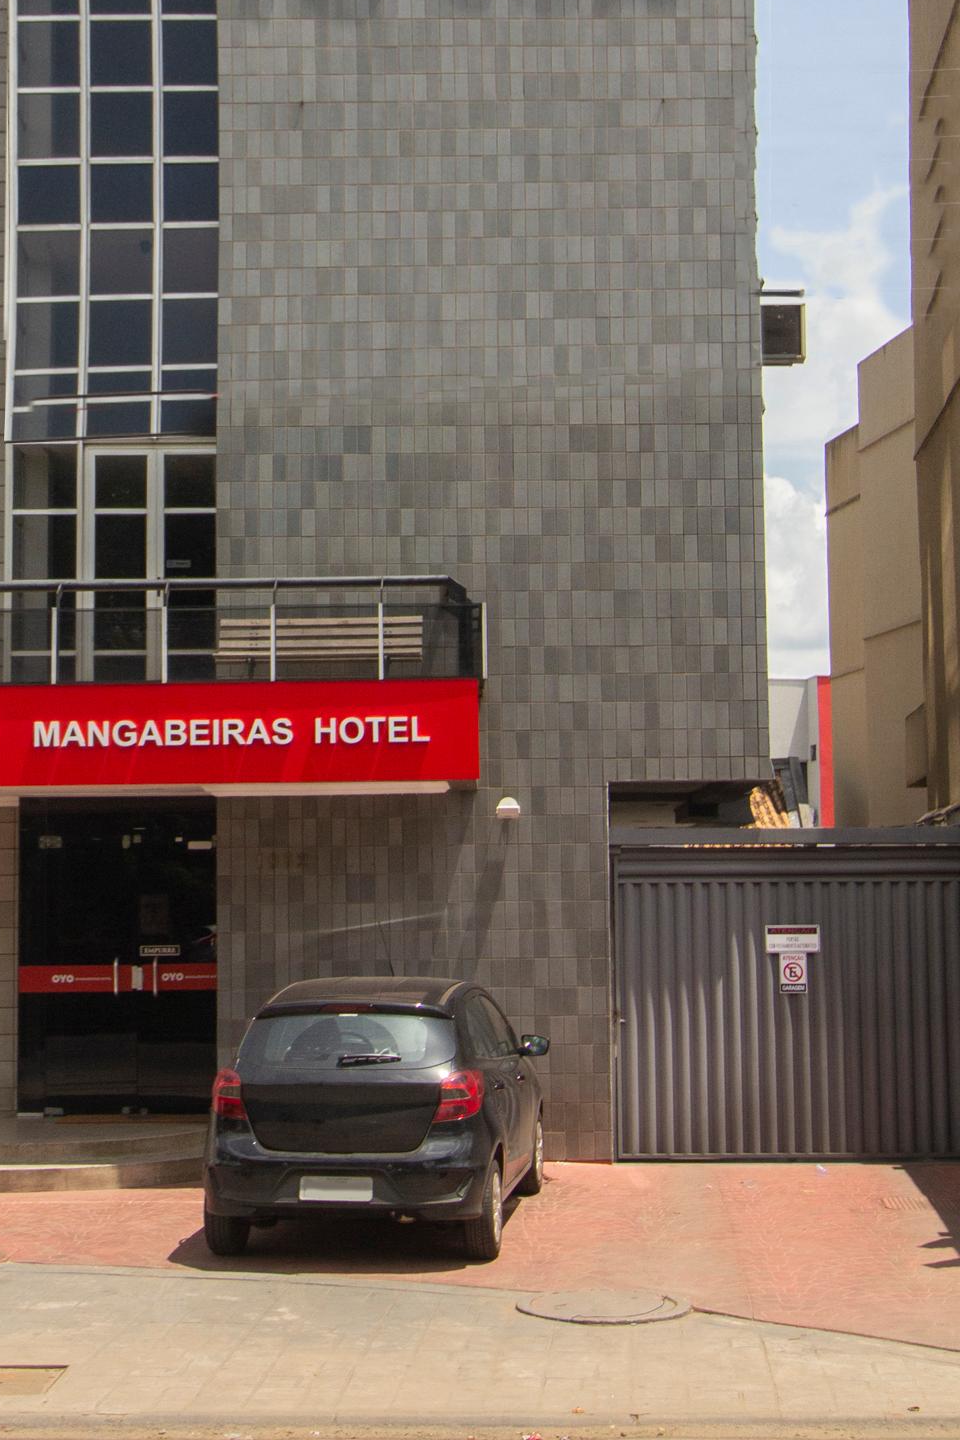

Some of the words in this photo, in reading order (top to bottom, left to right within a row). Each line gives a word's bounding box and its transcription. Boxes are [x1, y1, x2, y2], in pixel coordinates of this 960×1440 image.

[32, 717, 294, 749] MANGABEIRAS
[313, 715, 431, 745] HOTEL
[51, 974, 74, 984] OYO
[161, 972, 184, 982] OYO
